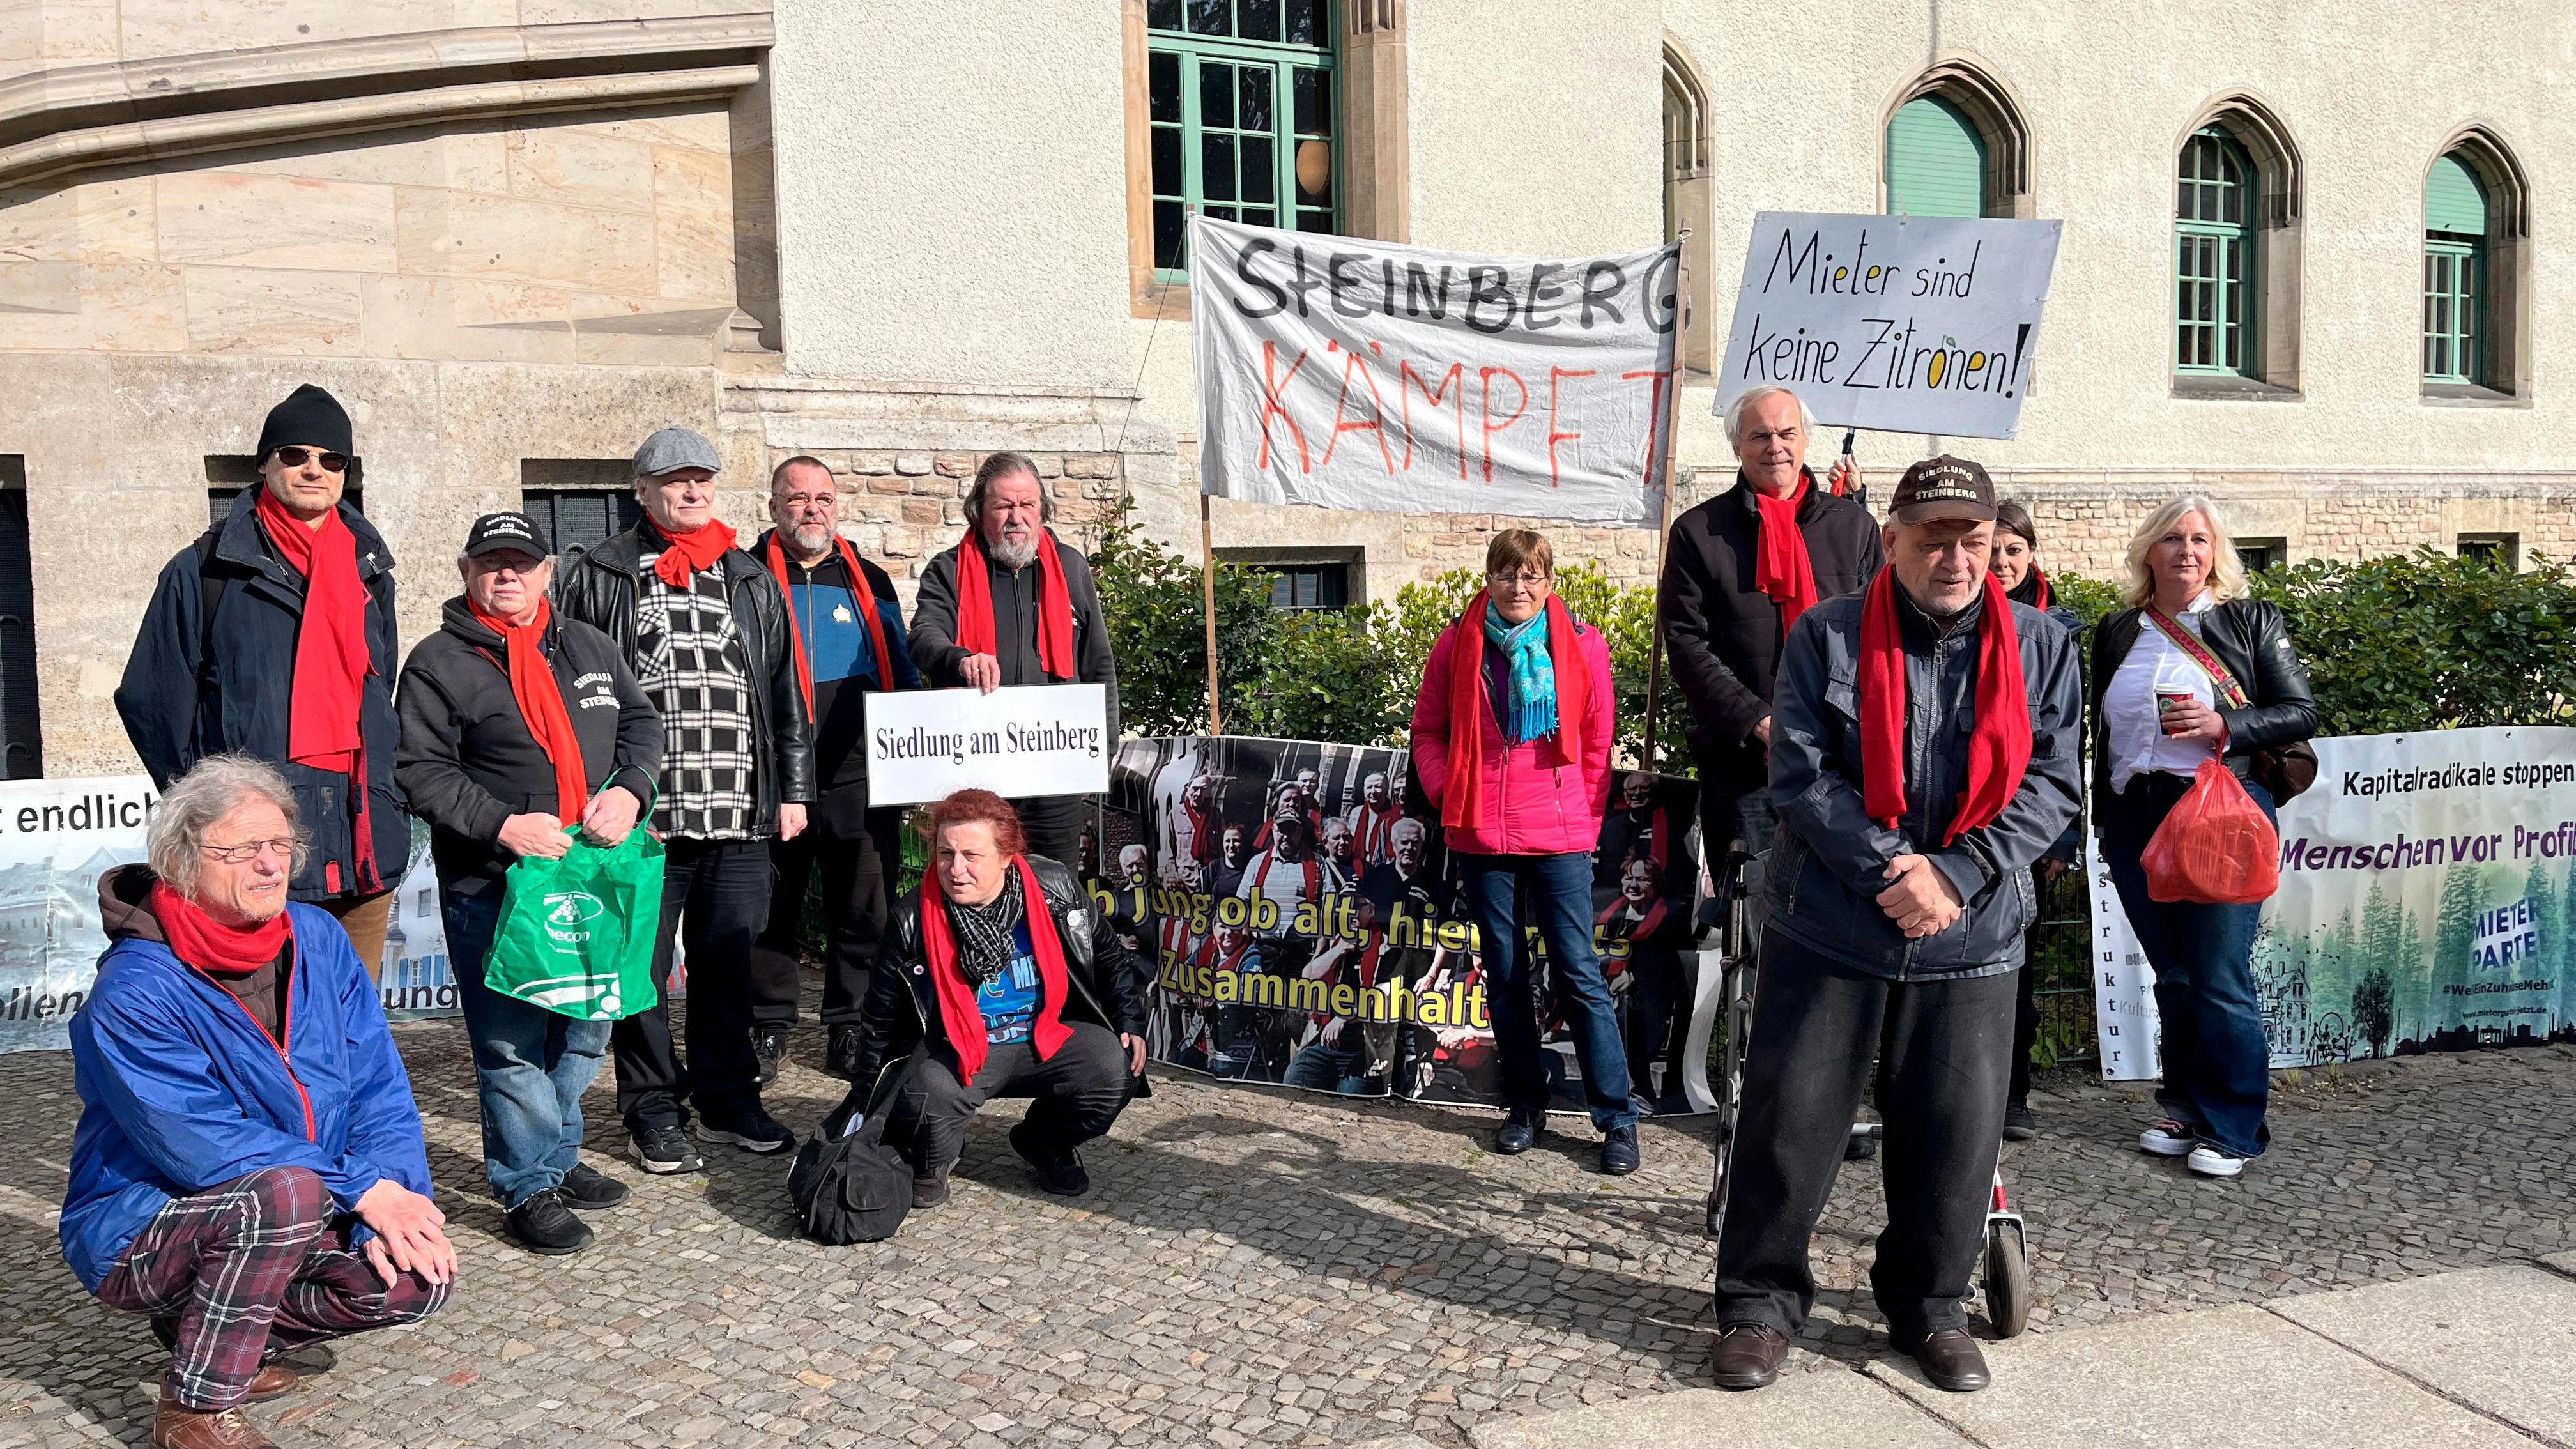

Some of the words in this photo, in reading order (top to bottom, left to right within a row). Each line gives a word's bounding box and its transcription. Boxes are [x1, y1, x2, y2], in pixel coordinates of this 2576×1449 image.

[1764, 227, 1900, 295] Mieter
[1911, 240, 1981, 298] sind
[1744, 314, 1839, 385] keine
[1843, 316, 2032, 399] Zitronen!
[1260, 339, 1671, 488] KÄMPFT
[1915, 488, 1977, 500] STEINBERG
[1918, 465, 1974, 482] SIEDLUNG
[1936, 479, 1954, 487] AM
[877, 726, 963, 765] Siedlung
[970, 730, 999, 755] am
[1006, 720, 1100, 758] Steinberg
[2343, 761, 2496, 801] Kapitalradikale
[2502, 763, 2575, 788] stoppen
[2279, 833, 2444, 873] Menschen
[2450, 834, 2502, 862] vor
[1219, 886, 1280, 931] ob
[1294, 893, 1371, 950] alt,
[1161, 949, 1492, 1031] Zusammenhalt
